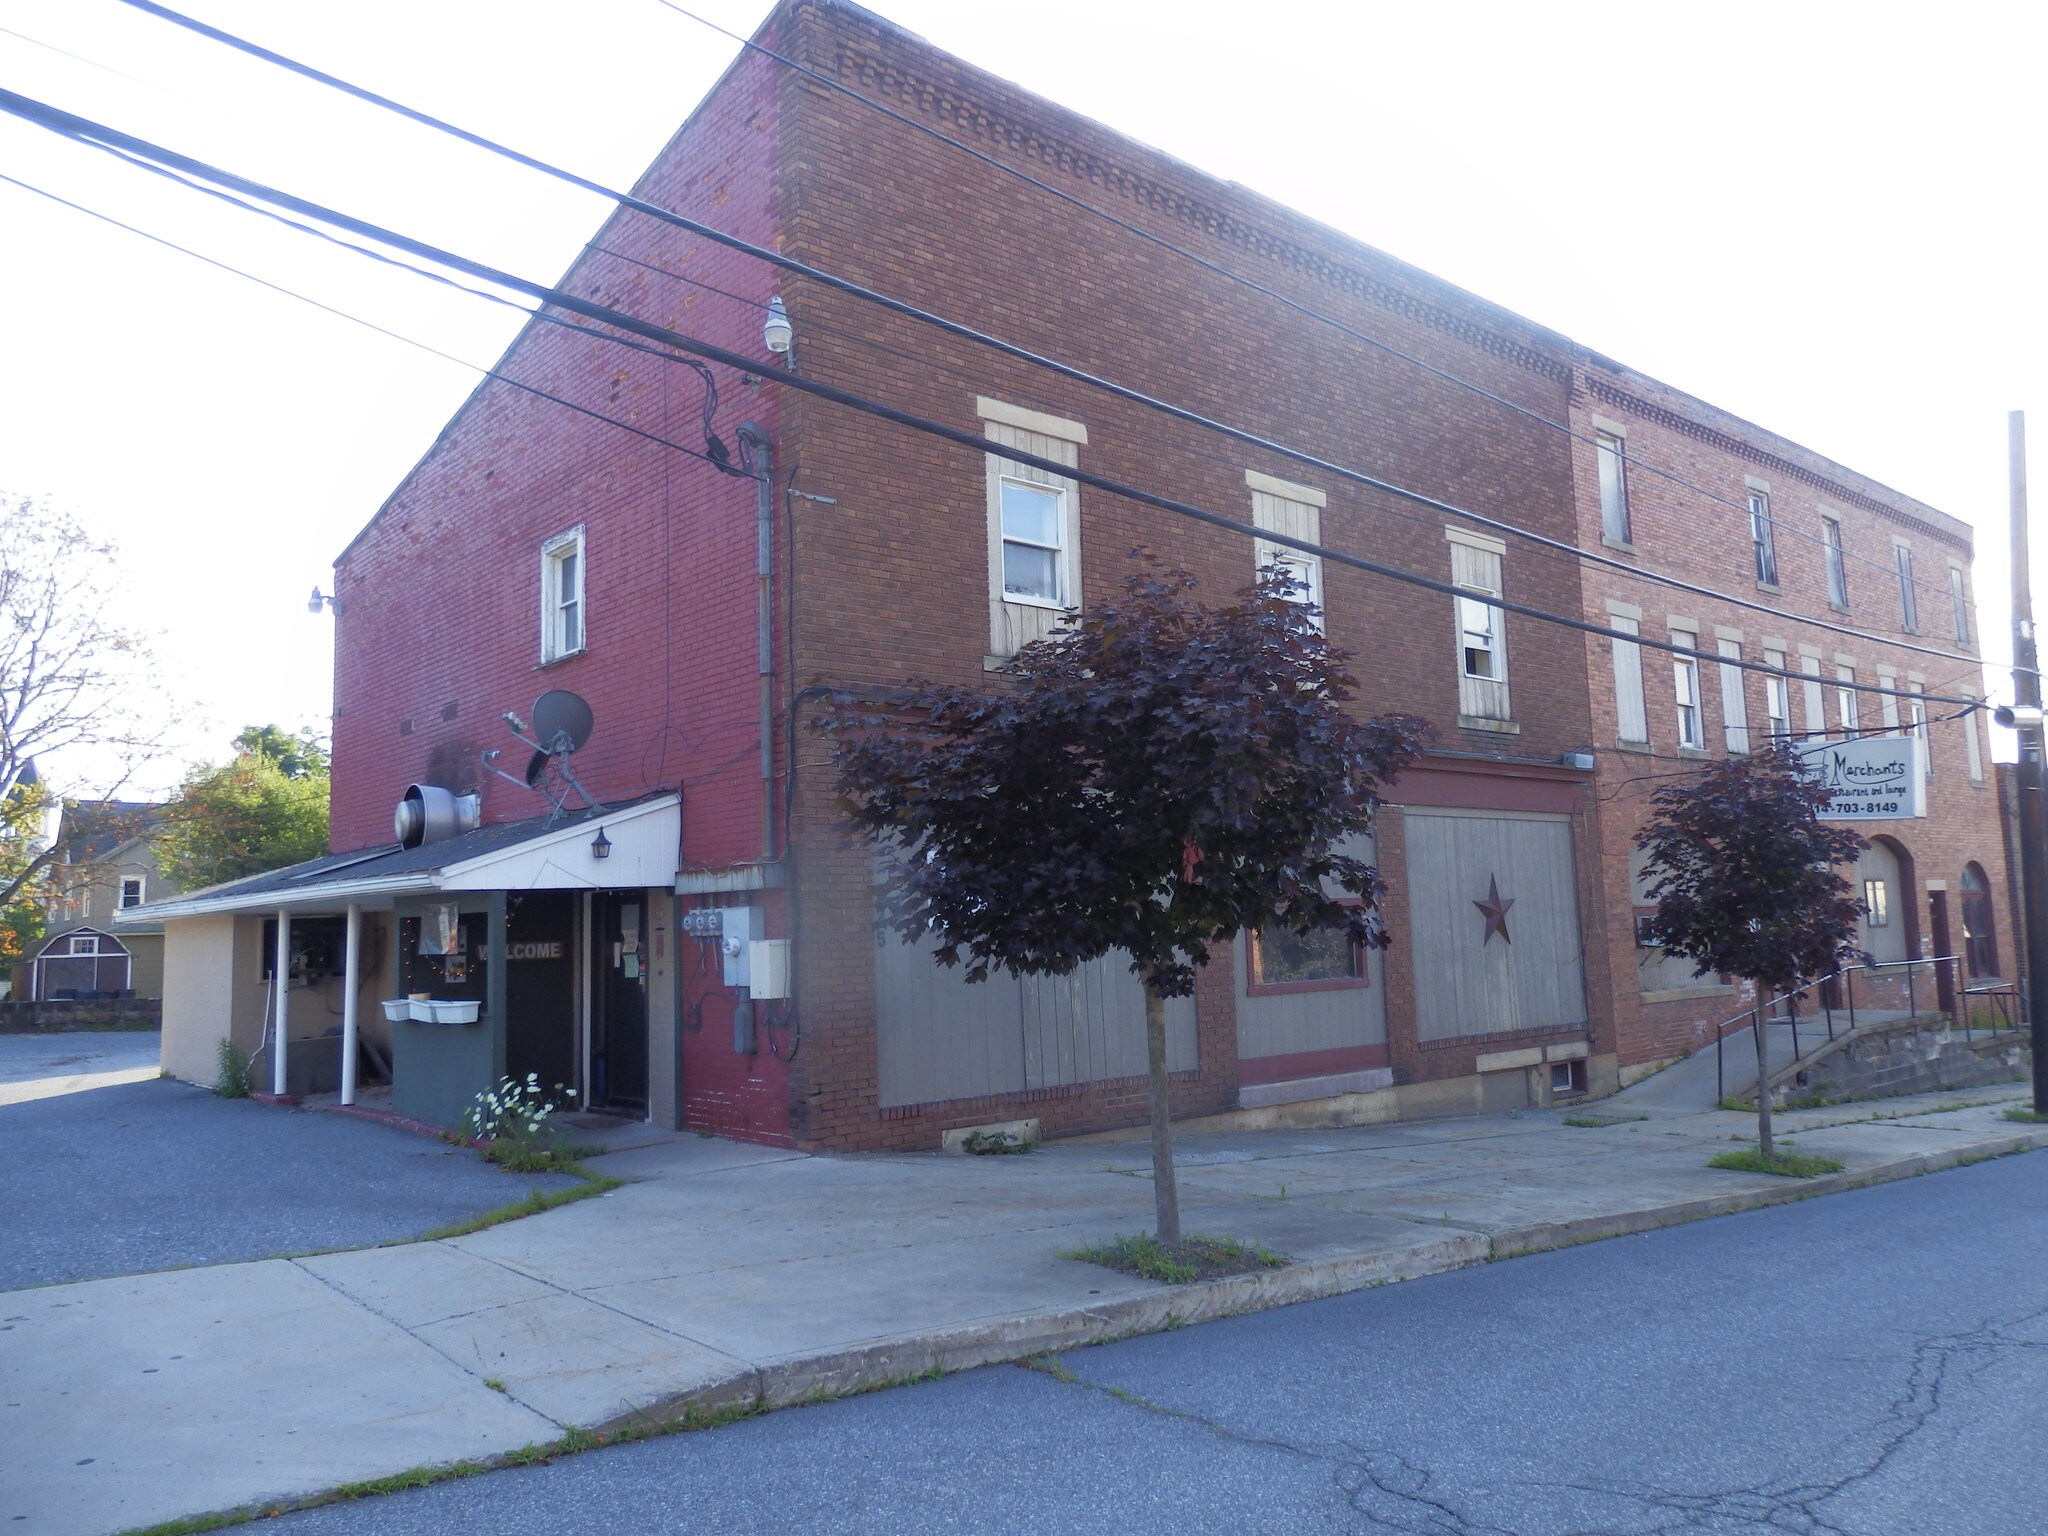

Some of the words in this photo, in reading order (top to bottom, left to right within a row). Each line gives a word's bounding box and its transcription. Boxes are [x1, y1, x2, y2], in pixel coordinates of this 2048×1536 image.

[1830, 751, 1906, 786] Merchants
[1829, 787, 1869, 797] staurant
[1871, 784, 1882, 796] and
[1885, 783, 1907, 798] lounge
[1809, 802, 1898, 814] 14-703-8149
[478, 942, 562, 960] WLCOME
